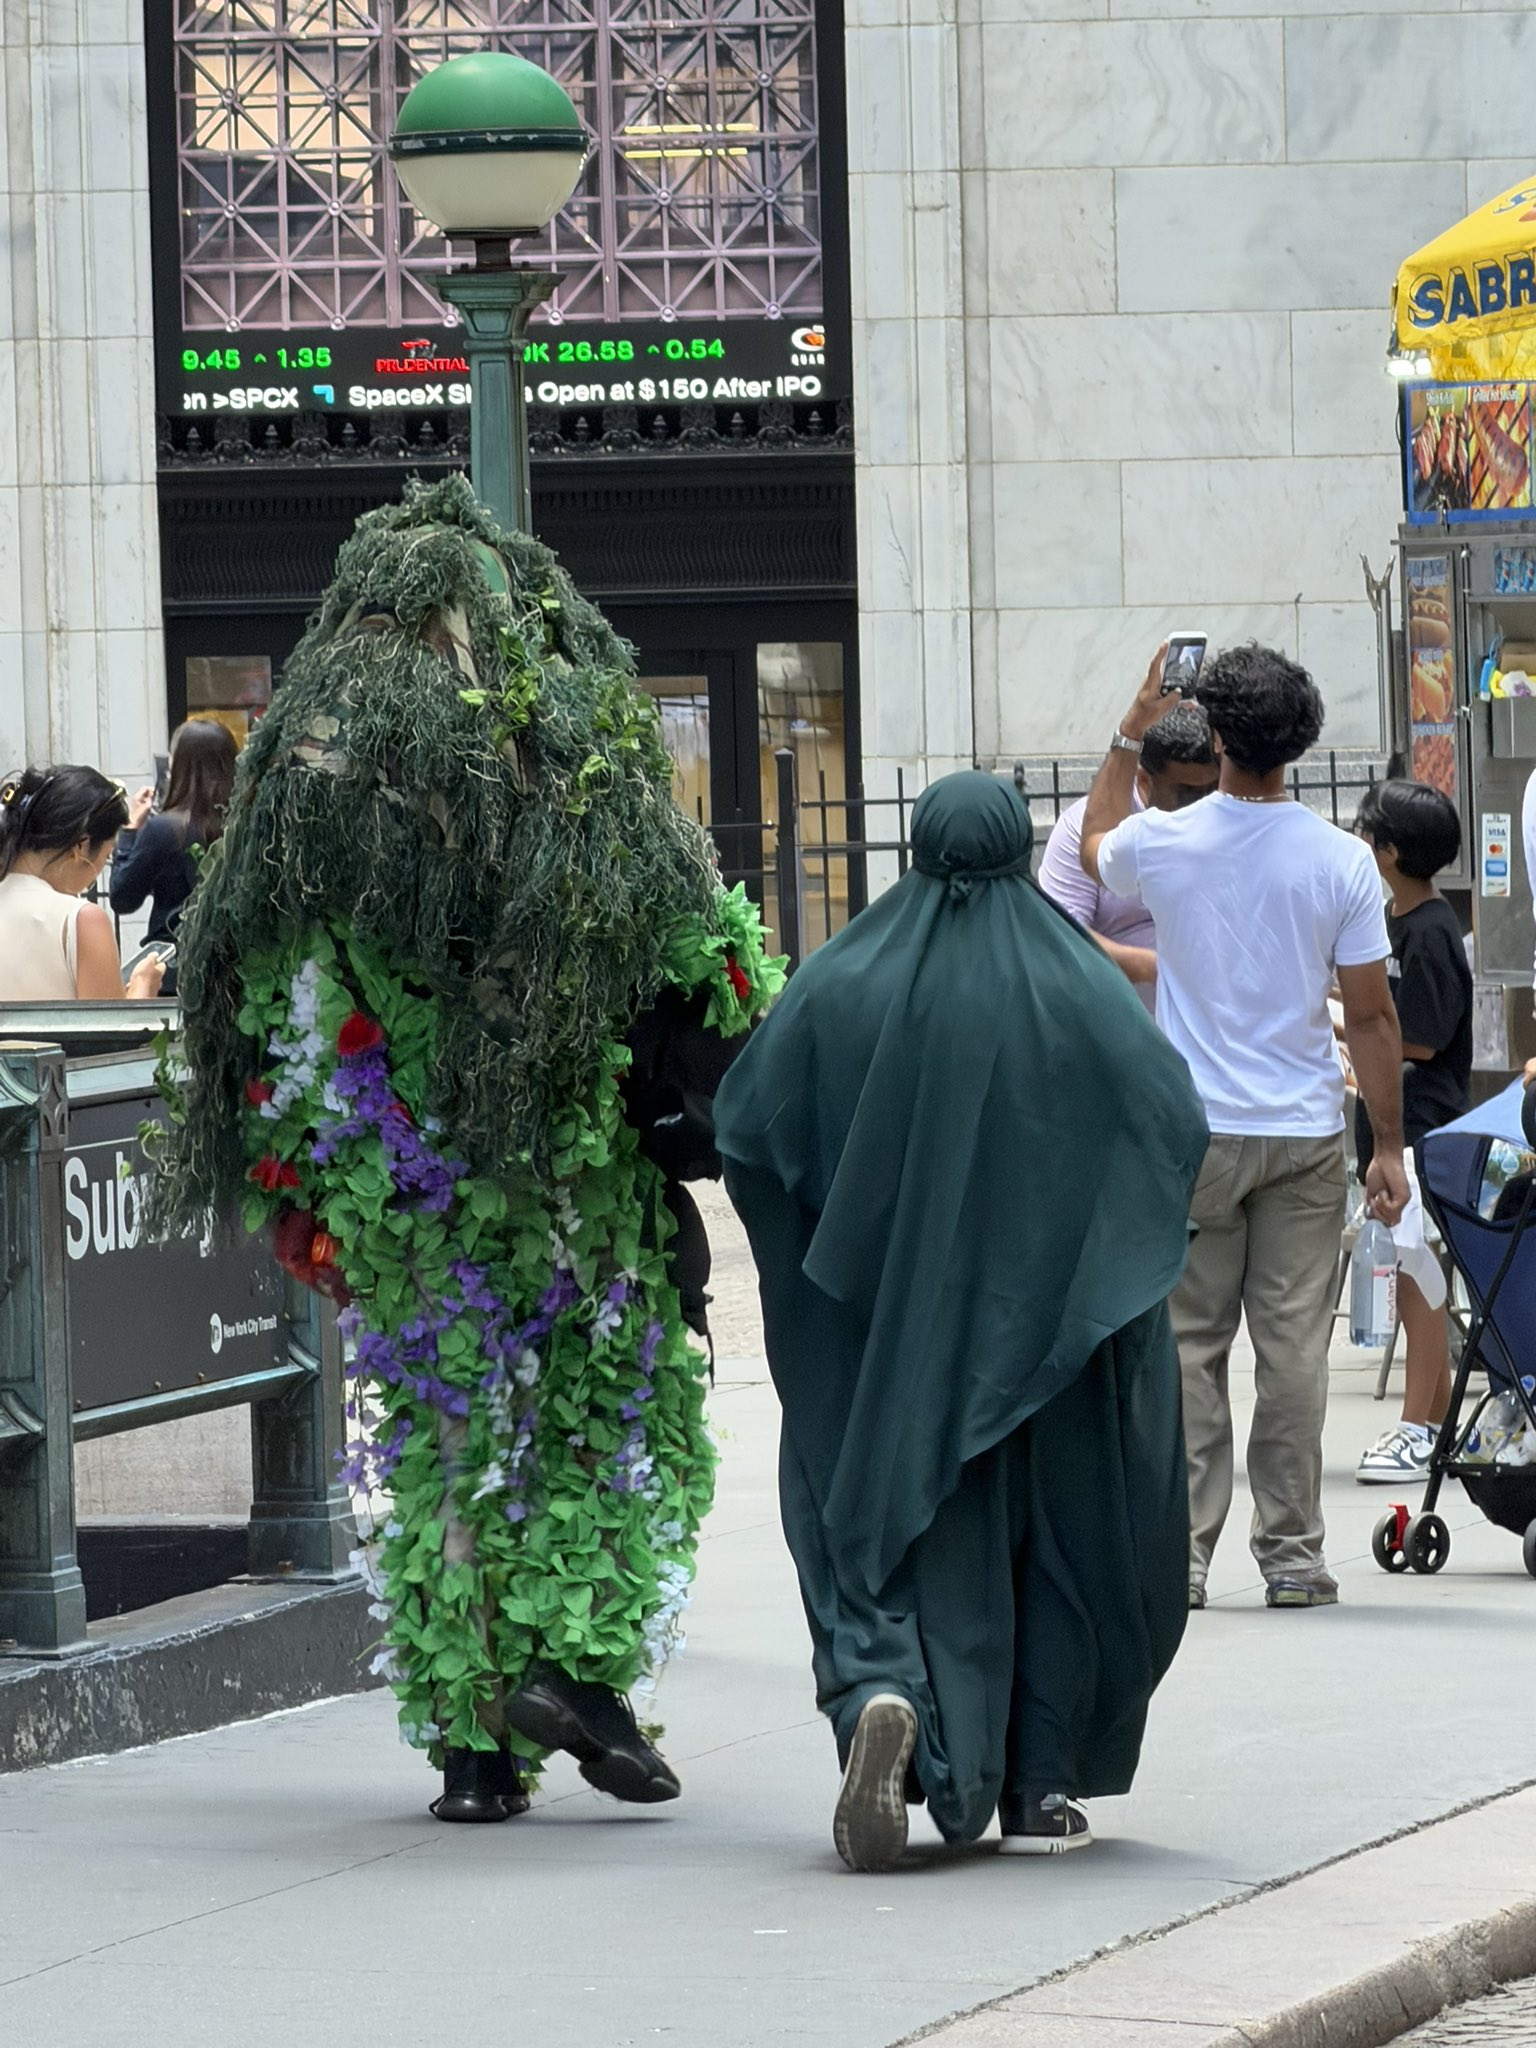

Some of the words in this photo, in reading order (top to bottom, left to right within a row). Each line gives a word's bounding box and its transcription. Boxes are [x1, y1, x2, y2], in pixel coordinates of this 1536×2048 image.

[1408, 248, 1536, 329] SABR
[182, 348, 241, 370] 9.45
[277, 347, 332, 369] 1.35
[557, 340, 634, 362] 26.58
[665, 338, 725, 360] 0.54
[375, 357, 470, 373] PRUDENTIAL
[348, 383, 445, 410] SpaceX
[537, 381, 605, 406] Open
[609, 380, 635, 401] at
[638, 377, 708, 402] $150
[712, 376, 772, 398] After
[776, 375, 822, 397] IPO
